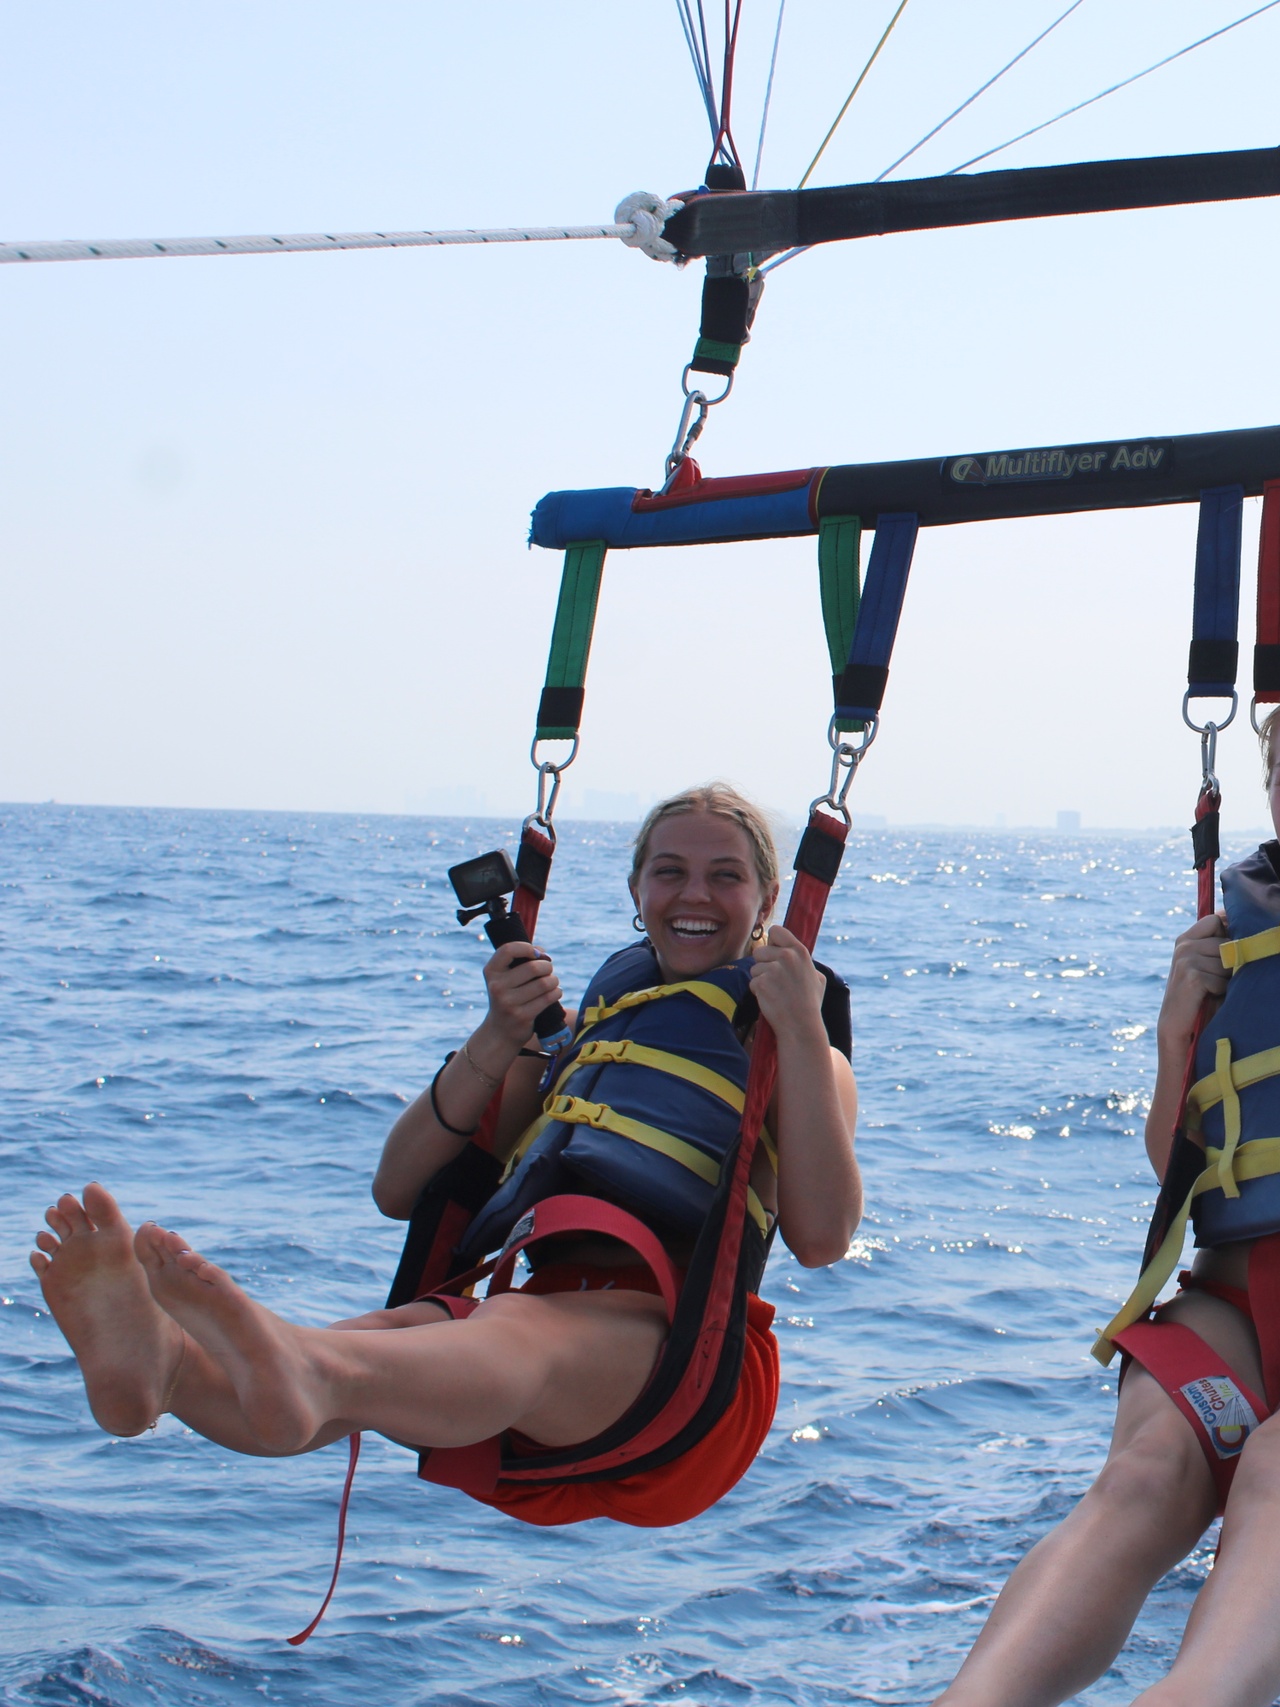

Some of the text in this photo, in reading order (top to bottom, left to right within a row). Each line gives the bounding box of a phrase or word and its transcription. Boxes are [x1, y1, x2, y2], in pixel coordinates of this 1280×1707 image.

[986, 445, 1163, 477] Multiflyer Adv
[1187, 1386, 1217, 1424] Custom
[1199, 1379, 1226, 1411] Chutes
